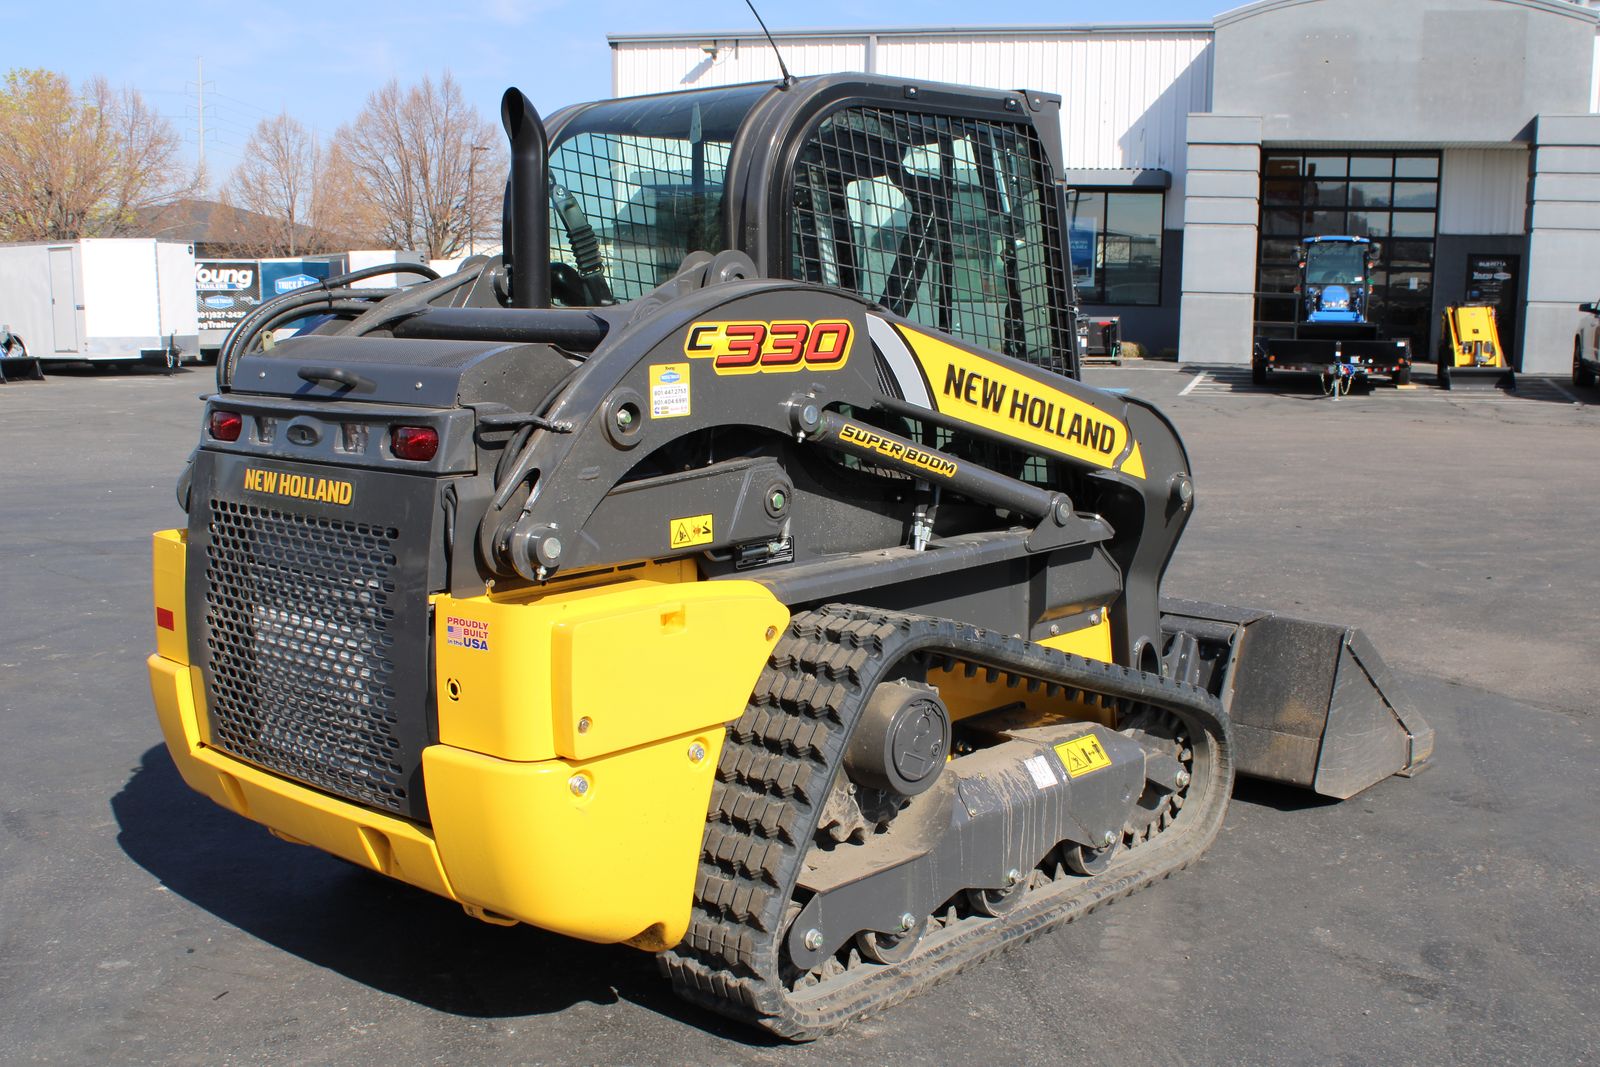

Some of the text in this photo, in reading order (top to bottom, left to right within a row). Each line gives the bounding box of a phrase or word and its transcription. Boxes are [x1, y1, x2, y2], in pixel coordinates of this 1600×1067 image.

[687, 324, 851, 368] C330
[943, 363, 1116, 455] NEW HOLLAND
[841, 426, 956, 474] SUPER BOOM
[244, 468, 353, 506] NEW HOLLAND
[447, 617, 488, 630] PROUDLY
[463, 629, 488, 639] BUILT
[463, 637, 488, 650] USA
